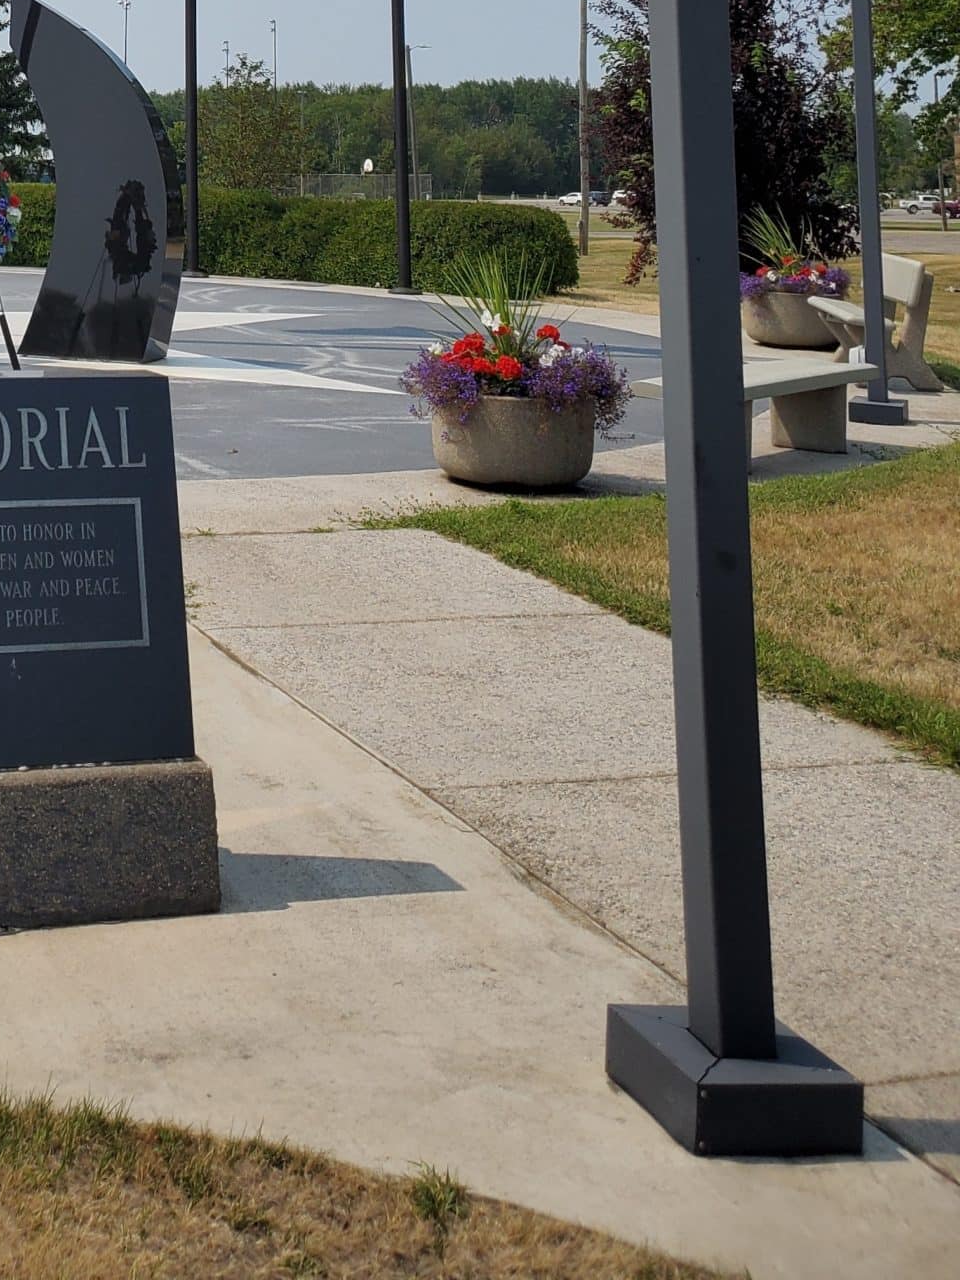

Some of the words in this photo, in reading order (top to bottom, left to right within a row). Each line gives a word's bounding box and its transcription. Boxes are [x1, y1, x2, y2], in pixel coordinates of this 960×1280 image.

[22, 522, 74, 542] HONOR
[80, 521, 96, 539] IN
[23, 551, 55, 570] AND
[60, 549, 115, 568] WOMEN
[0, 581, 31, 599] WAR
[40, 579, 70, 597] AND
